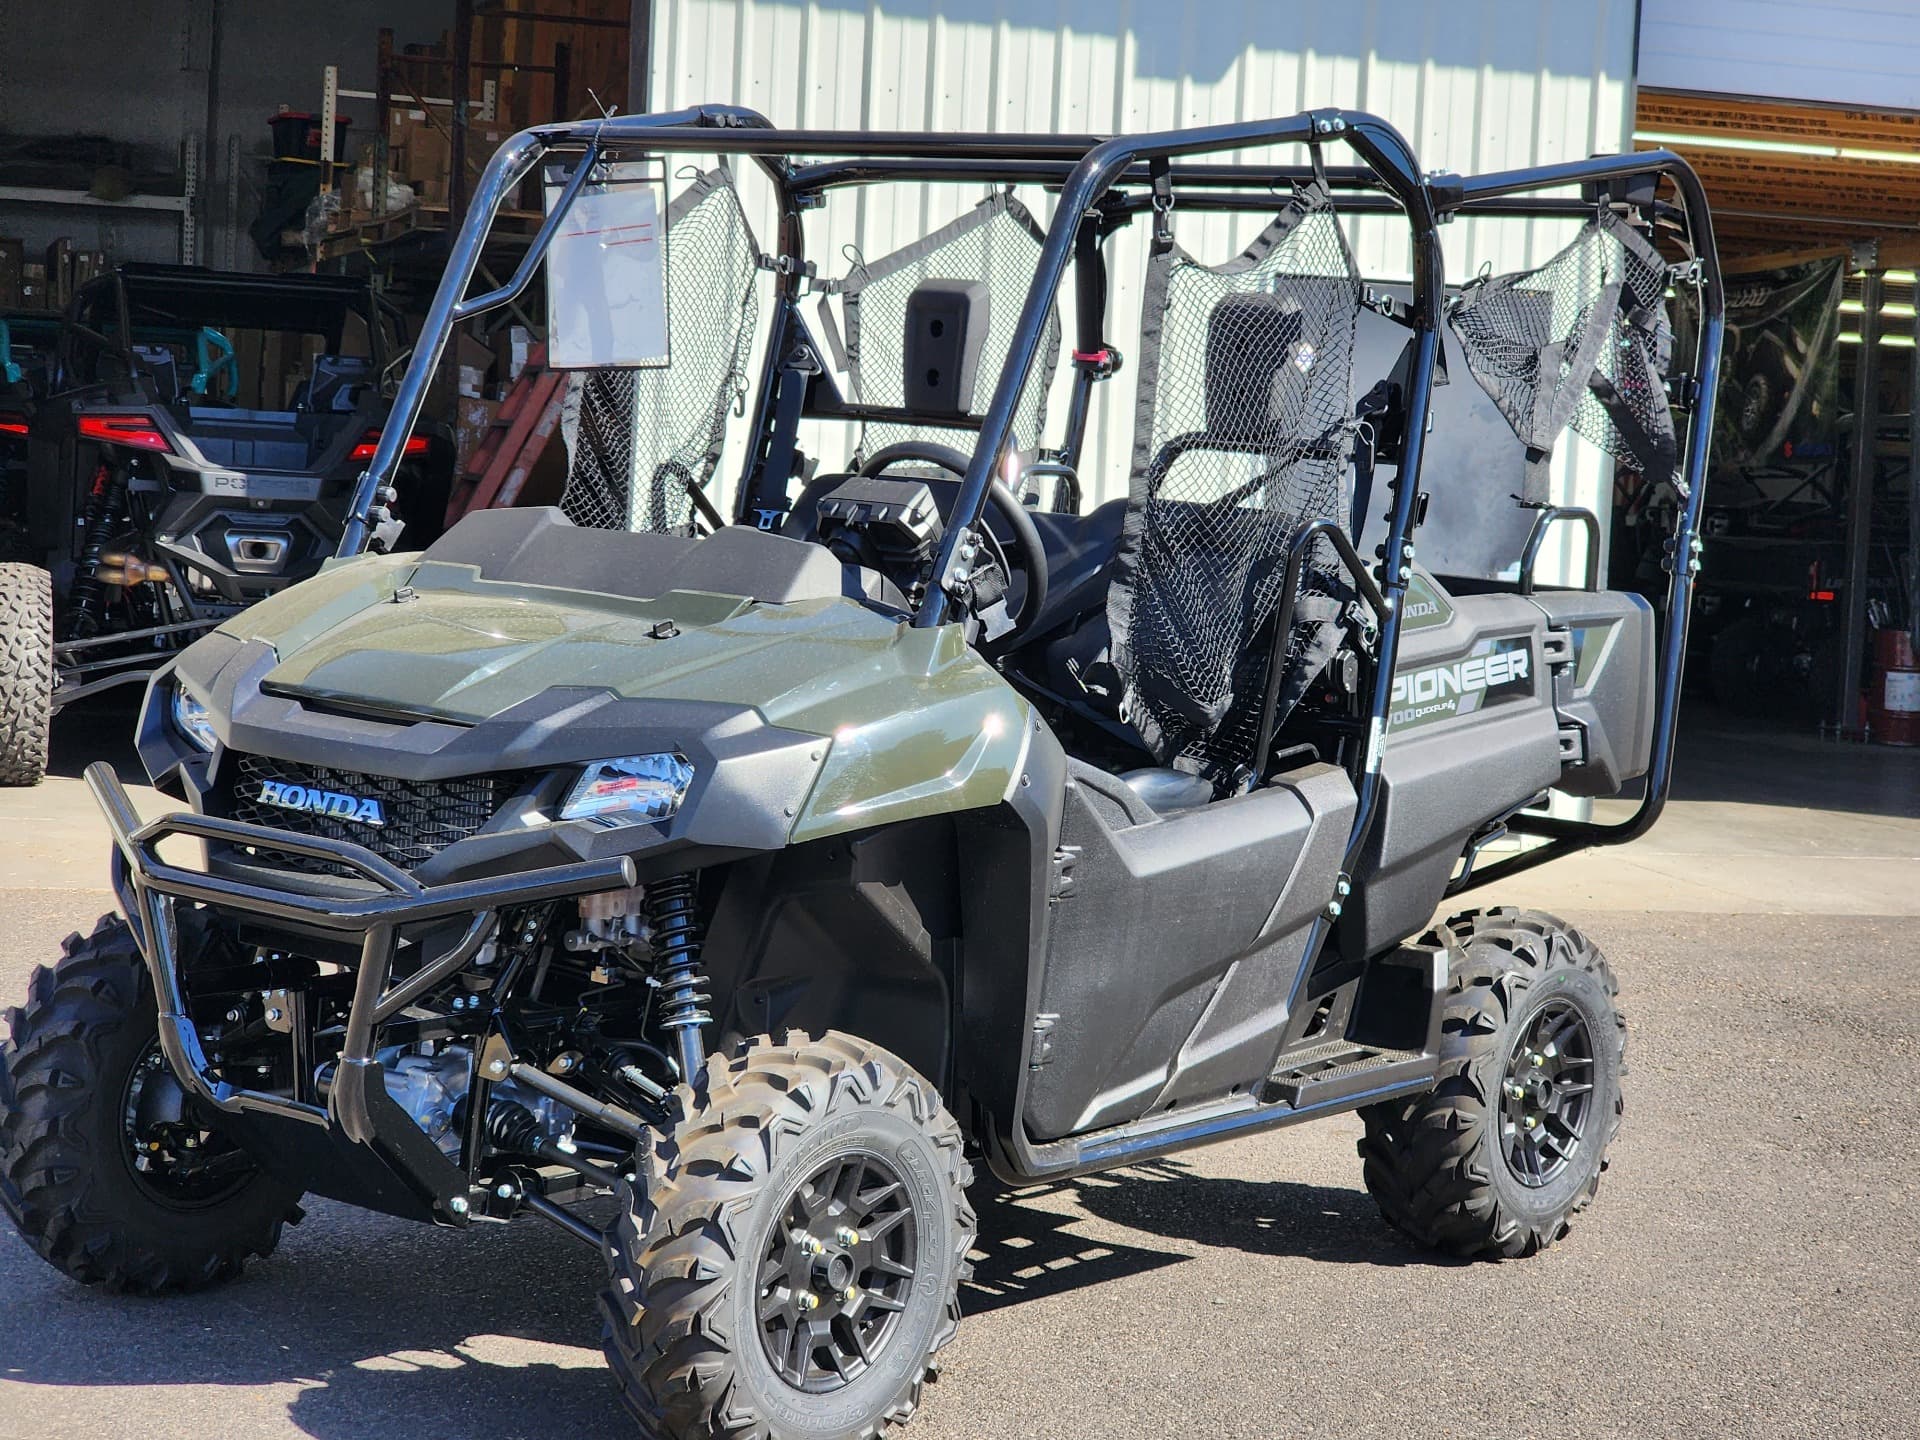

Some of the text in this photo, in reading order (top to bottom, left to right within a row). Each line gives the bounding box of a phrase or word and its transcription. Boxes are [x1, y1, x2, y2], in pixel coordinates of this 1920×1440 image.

[1402, 601, 1439, 618] NDA
[1391, 648, 1529, 705] PIONEER
[1390, 708, 1415, 725] 00
[256, 780, 385, 826] HONDA
